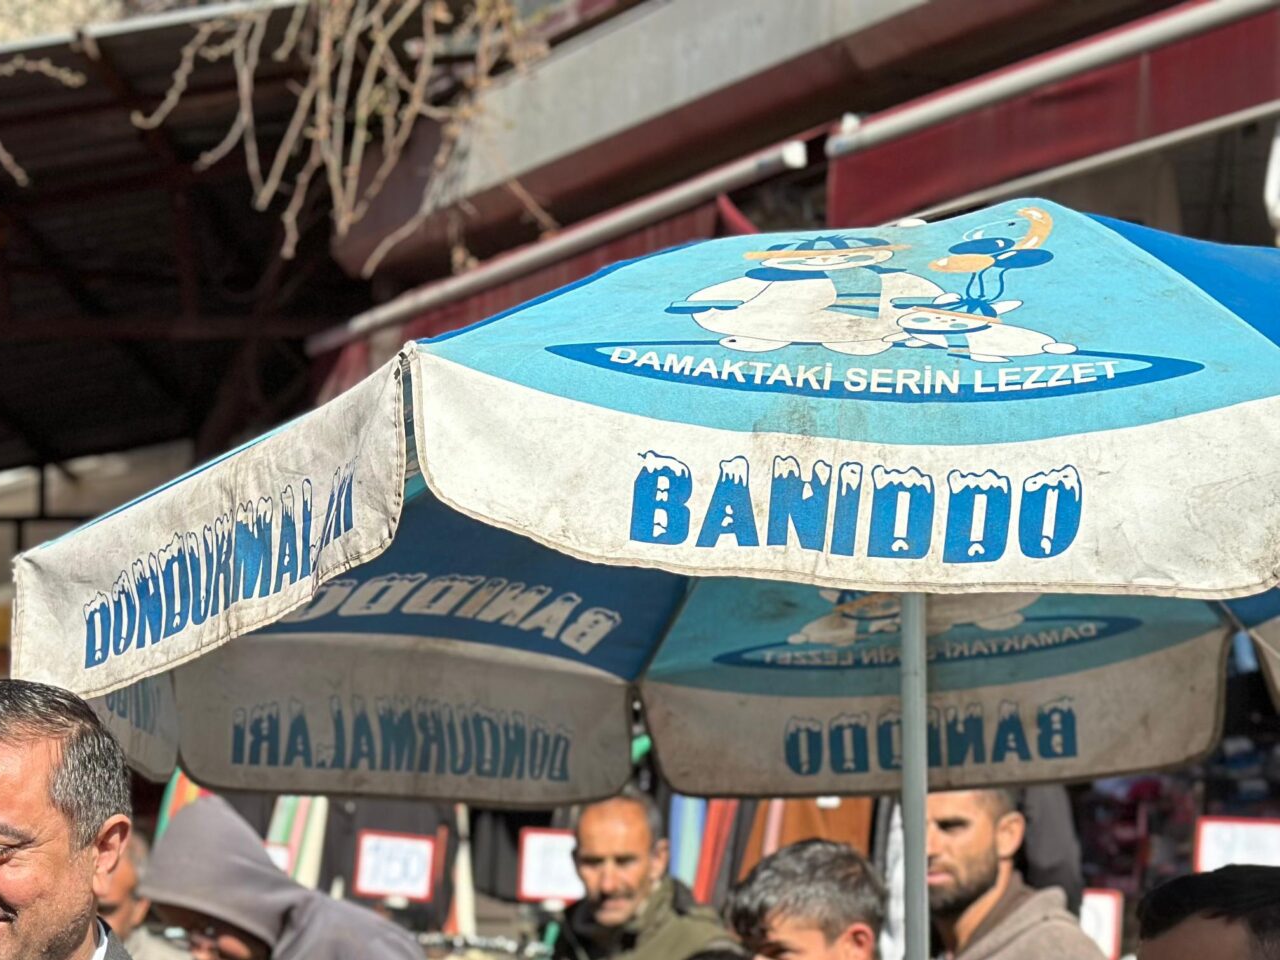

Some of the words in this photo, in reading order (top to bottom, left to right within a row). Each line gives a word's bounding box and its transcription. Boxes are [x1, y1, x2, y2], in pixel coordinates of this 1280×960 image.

[609, 346, 832, 391] DAMAKTAKİ
[843, 363, 960, 395] SERİN
[973, 360, 1120, 394] LEZZET
[629, 450, 1083, 563] BANIDDO
